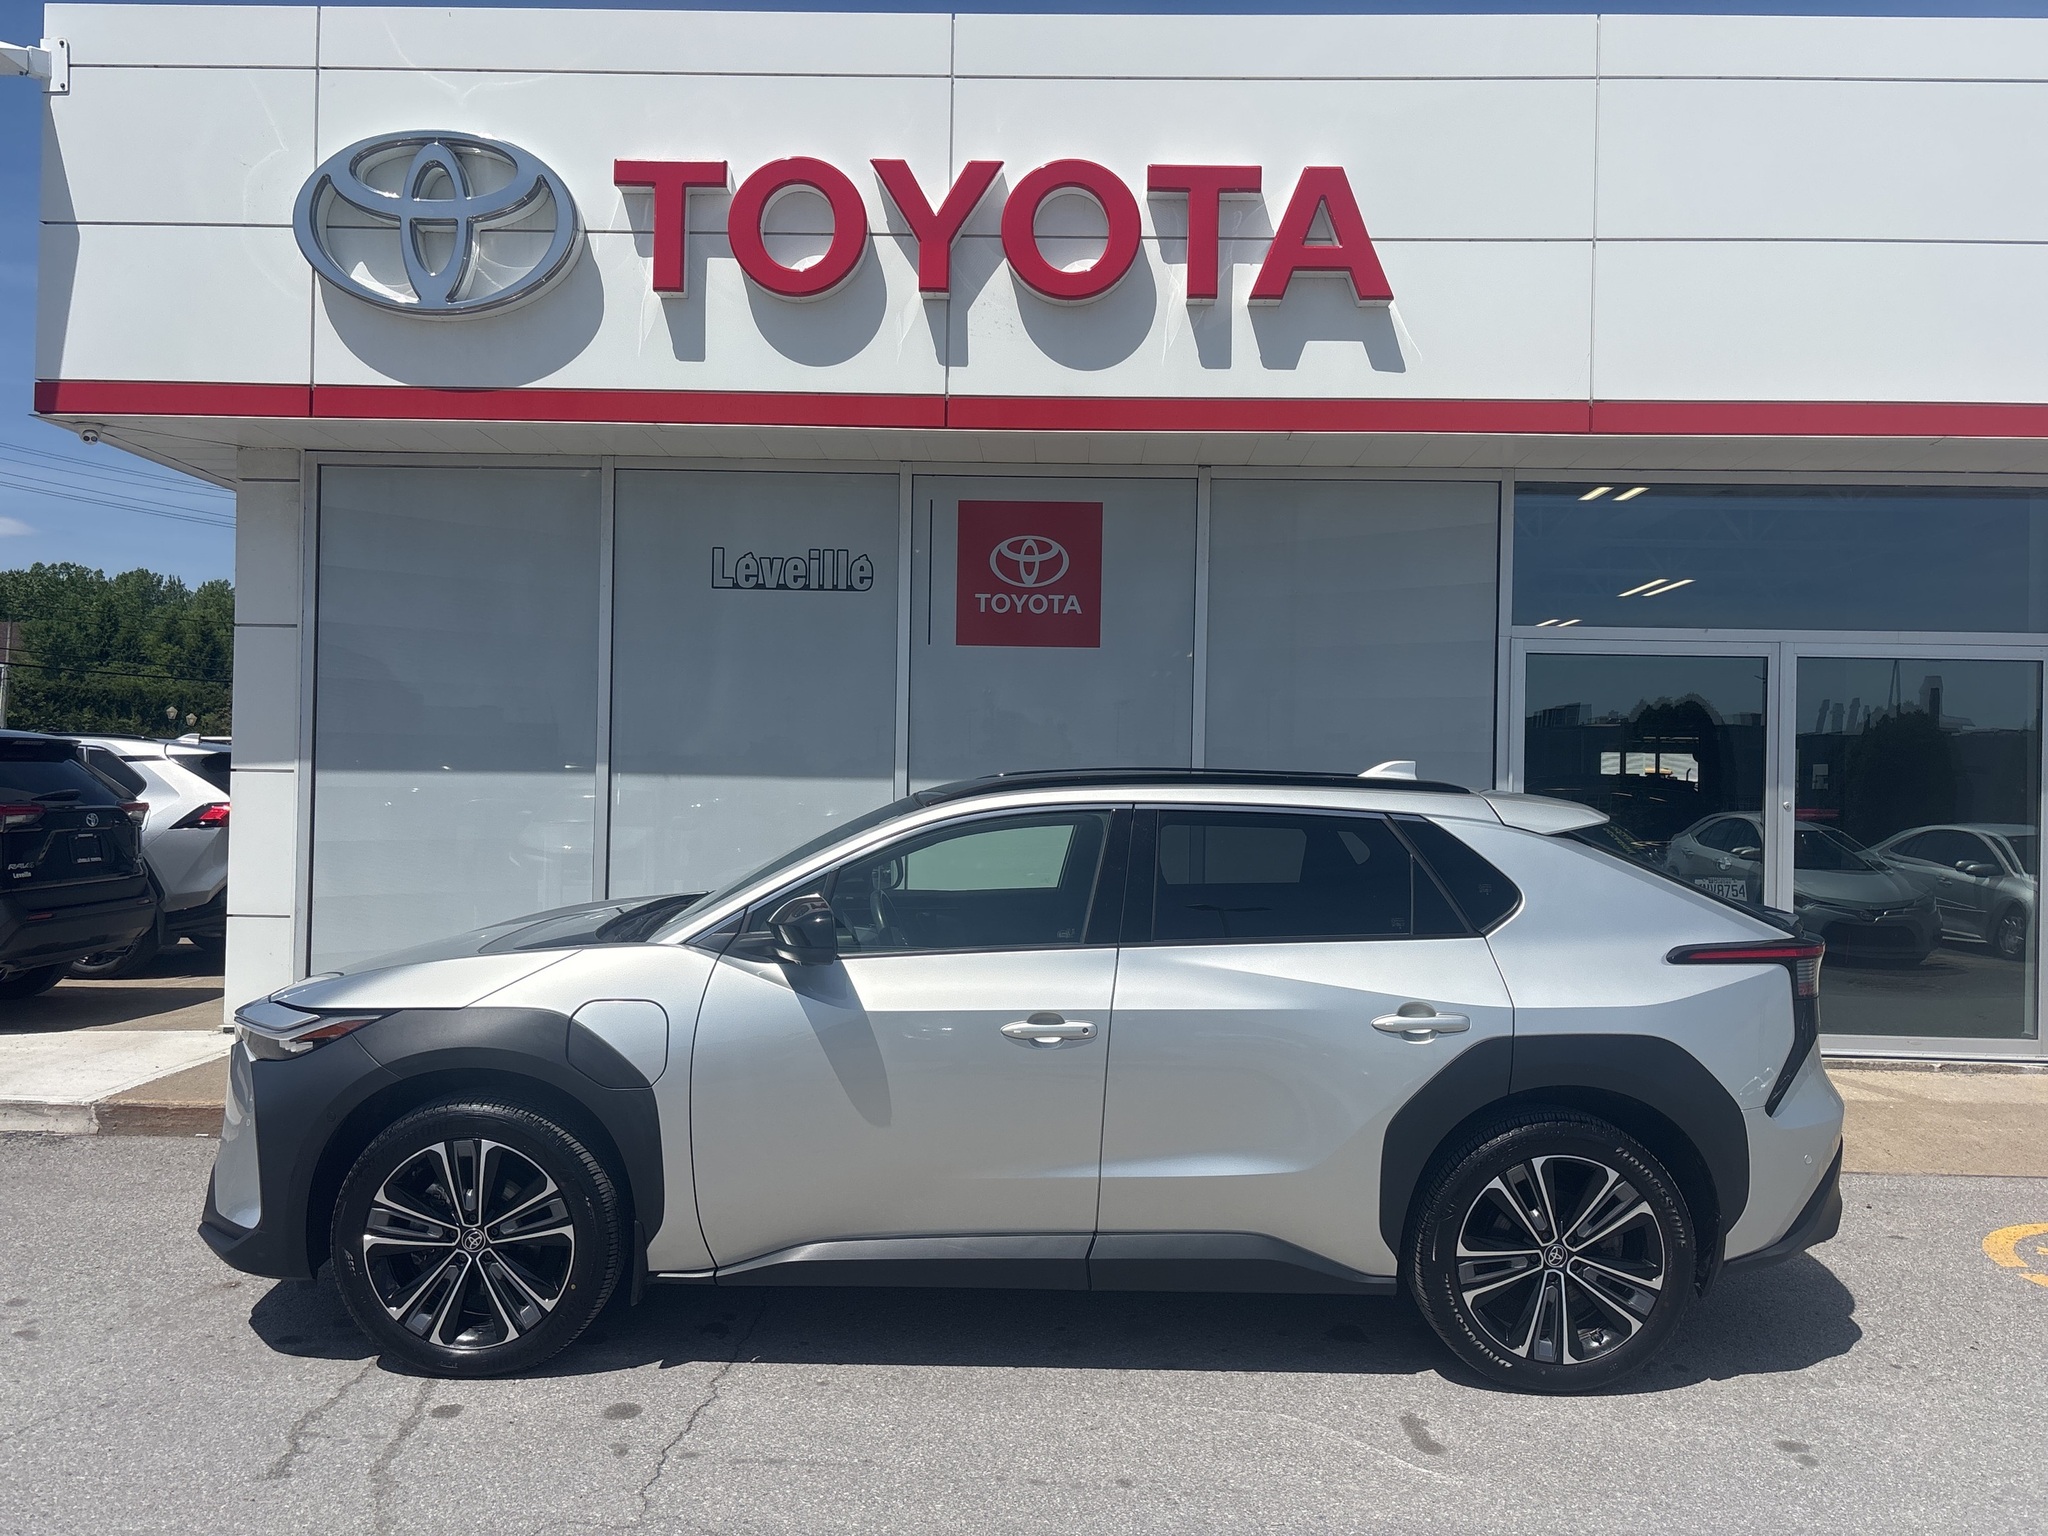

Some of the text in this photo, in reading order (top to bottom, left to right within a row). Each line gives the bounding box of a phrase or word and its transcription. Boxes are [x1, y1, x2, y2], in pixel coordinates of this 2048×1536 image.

[614, 156, 1395, 306] TOYOTA
[712, 547, 874, 592] Léveillé
[974, 593, 1083, 614] TOYOTA
